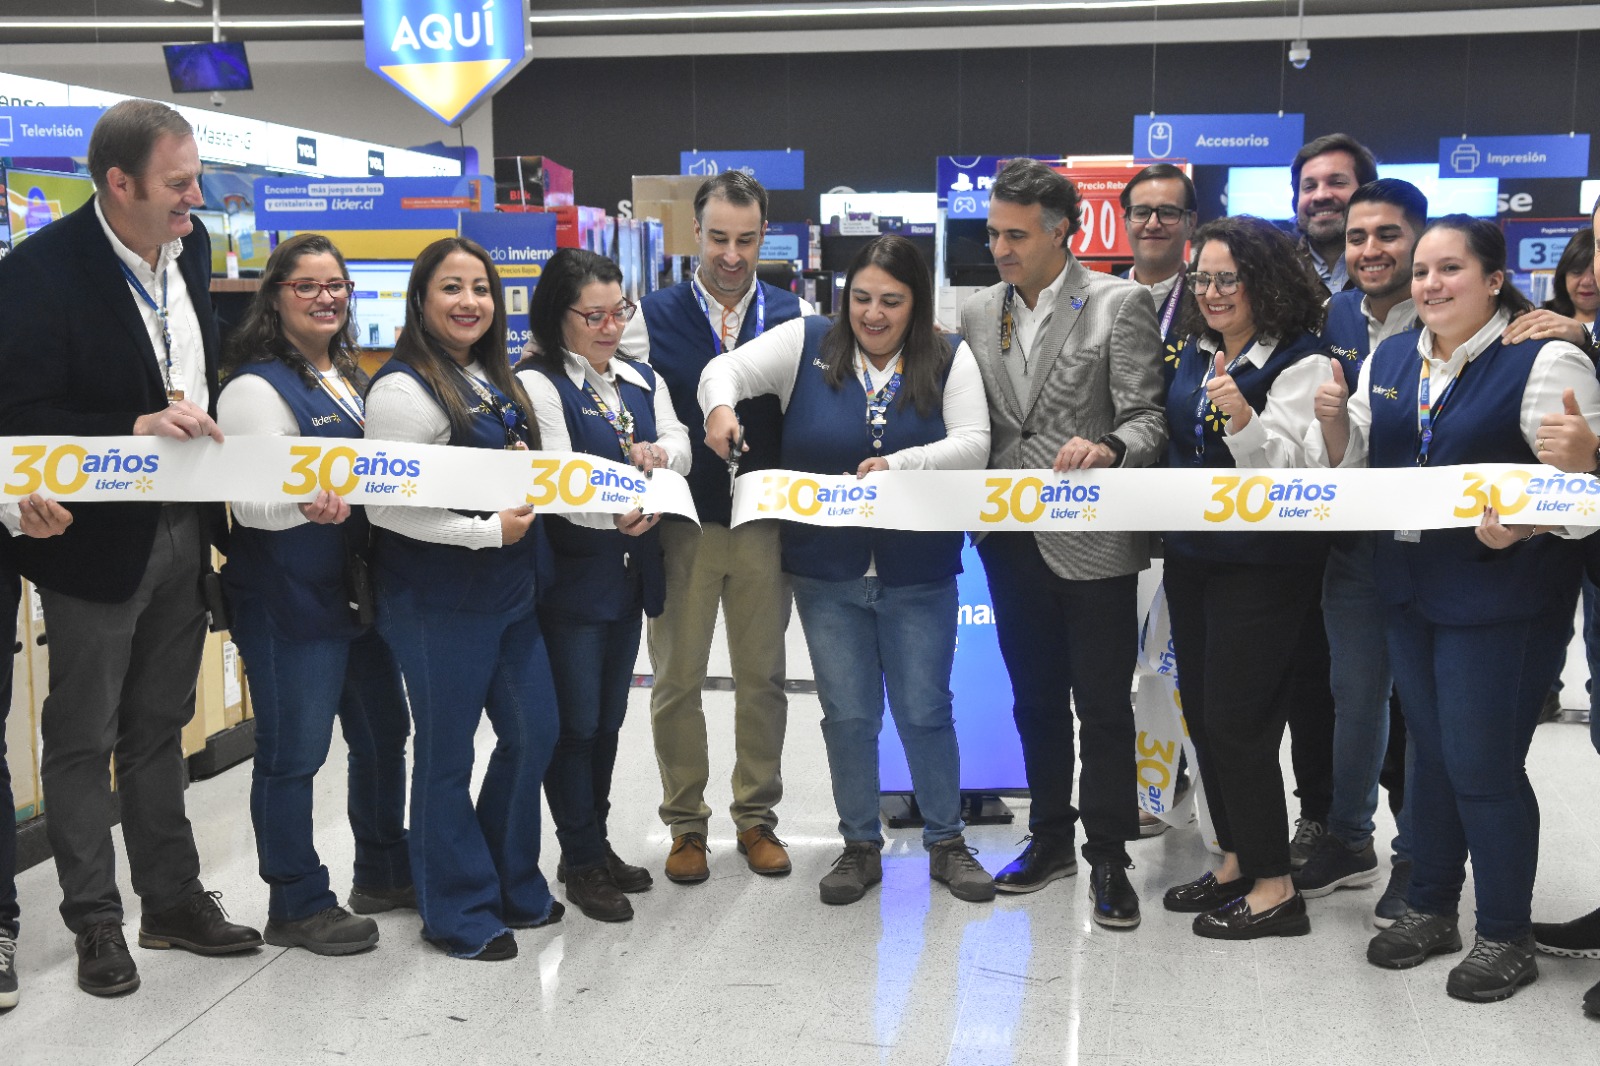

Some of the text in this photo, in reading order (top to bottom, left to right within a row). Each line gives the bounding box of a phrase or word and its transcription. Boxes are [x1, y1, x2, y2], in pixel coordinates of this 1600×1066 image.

[390, 0, 495, 52] AQUÍ
[20, 124, 83, 137] Televisión
[297, 143, 316, 159] TCL
[1195, 133, 1269, 148] Accesorios
[368, 156, 384, 171] TCL
[1486, 150, 1547, 164] Impresión
[264, 184, 307, 195] Encuentra
[1078, 181, 1105, 191] Precio
[1529, 242, 1547, 265] 3
[4, 444, 160, 497] 30 años
[282, 445, 421, 497] 30 años
[525, 459, 647, 506] 30 años
[757, 476, 878, 517] 30 años
[979, 476, 1101, 524] 30 años
[1203, 475, 1338, 523] 30 años
[1453, 469, 1600, 519] 30 años
[1136, 731, 1176, 792] 30
